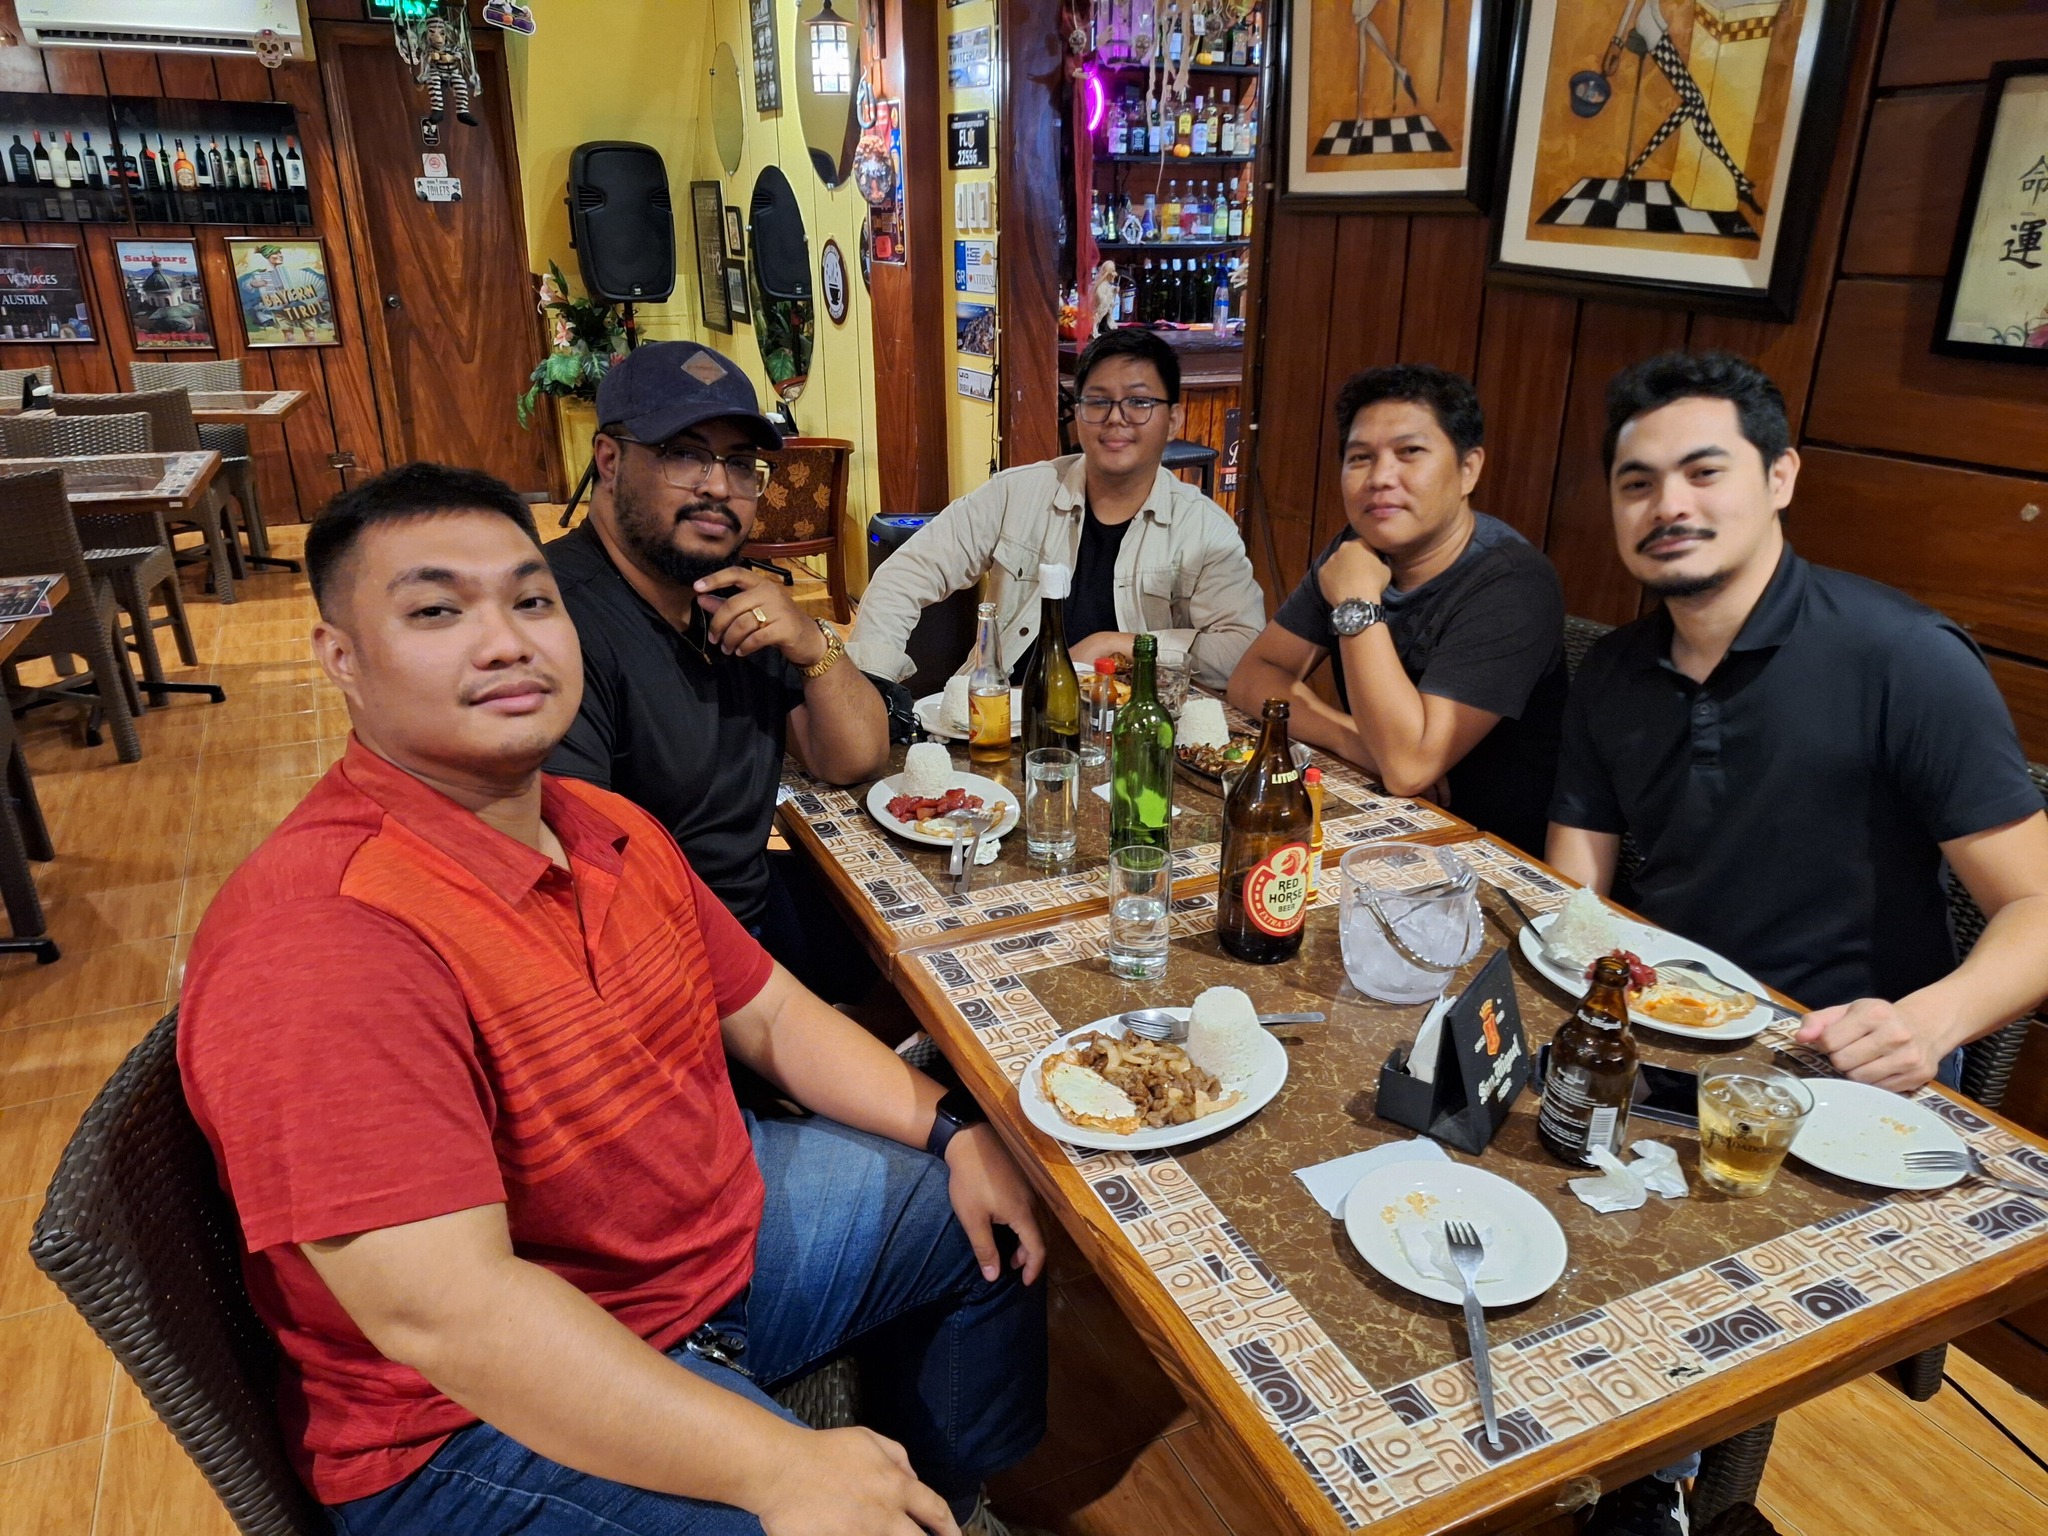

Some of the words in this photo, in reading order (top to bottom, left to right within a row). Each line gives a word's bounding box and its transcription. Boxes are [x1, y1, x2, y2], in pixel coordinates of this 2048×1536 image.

[957, 149, 978, 166] 22556
[427, 185, 451, 196] TOILETS
[124, 254, 188, 265] Salzburg
[7, 274, 58, 287] VOYAGES
[956, 269, 966, 284] GR
[2, 294, 48, 305] AUSTRIA
[262, 284, 318, 308] BAYERN
[284, 301, 327, 321] TIROL
[1278, 878, 1299, 893] RED
[1269, 888, 1303, 904] HORSE
[1278, 903, 1296, 913] BEER
[1259, 910, 1281, 928] EXTRA
